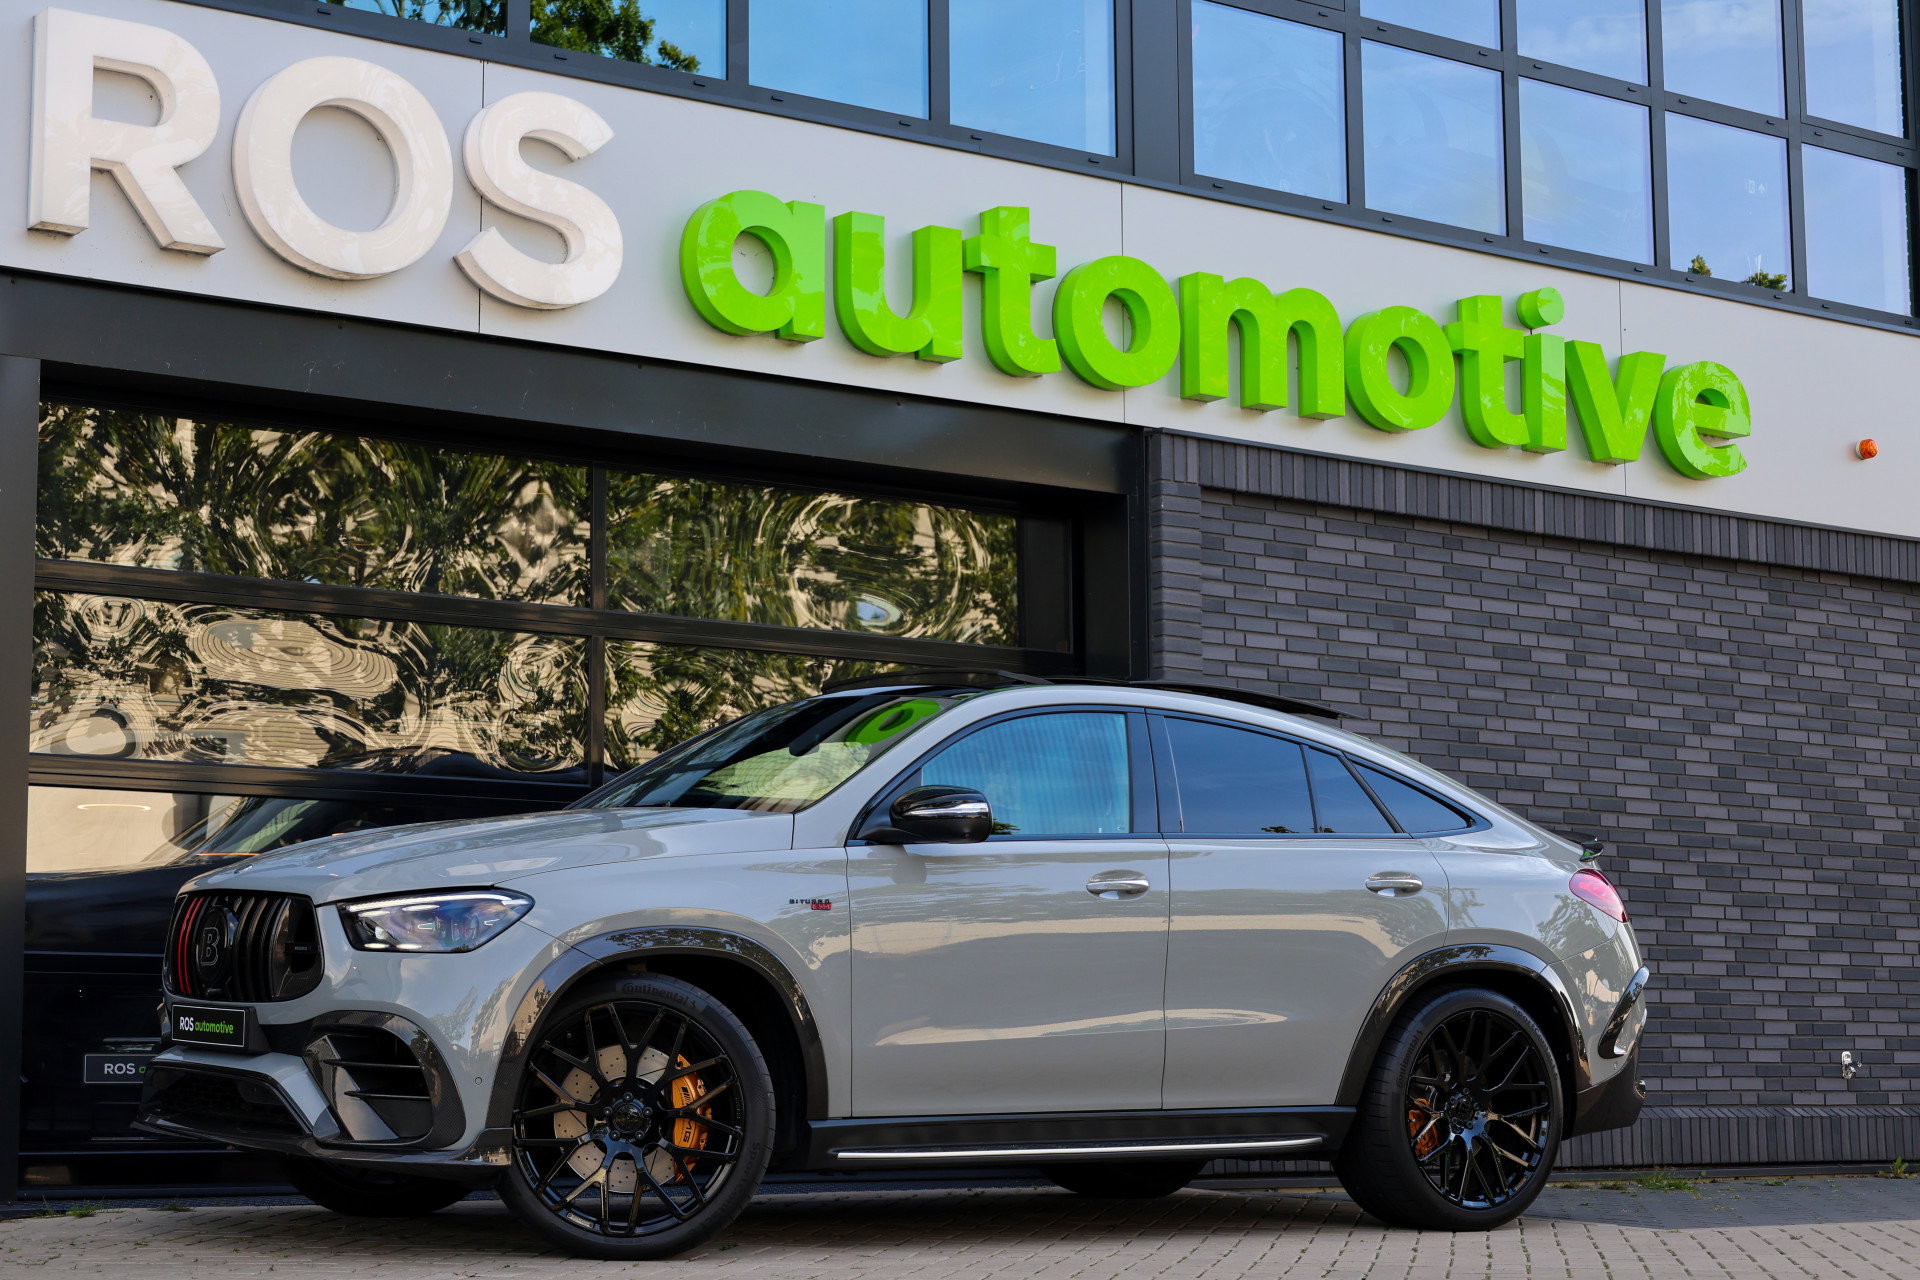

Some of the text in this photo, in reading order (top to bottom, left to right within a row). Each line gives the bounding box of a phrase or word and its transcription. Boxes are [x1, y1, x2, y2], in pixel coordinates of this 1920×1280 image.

[27, 6, 1750, 480] ROS automotive
[622, 982, 689, 1006] Continental
[180, 1016, 234, 1034] ROS automotive
[104, 1063, 136, 1075] ROS
[1396, 1034, 1420, 1088] Continental
